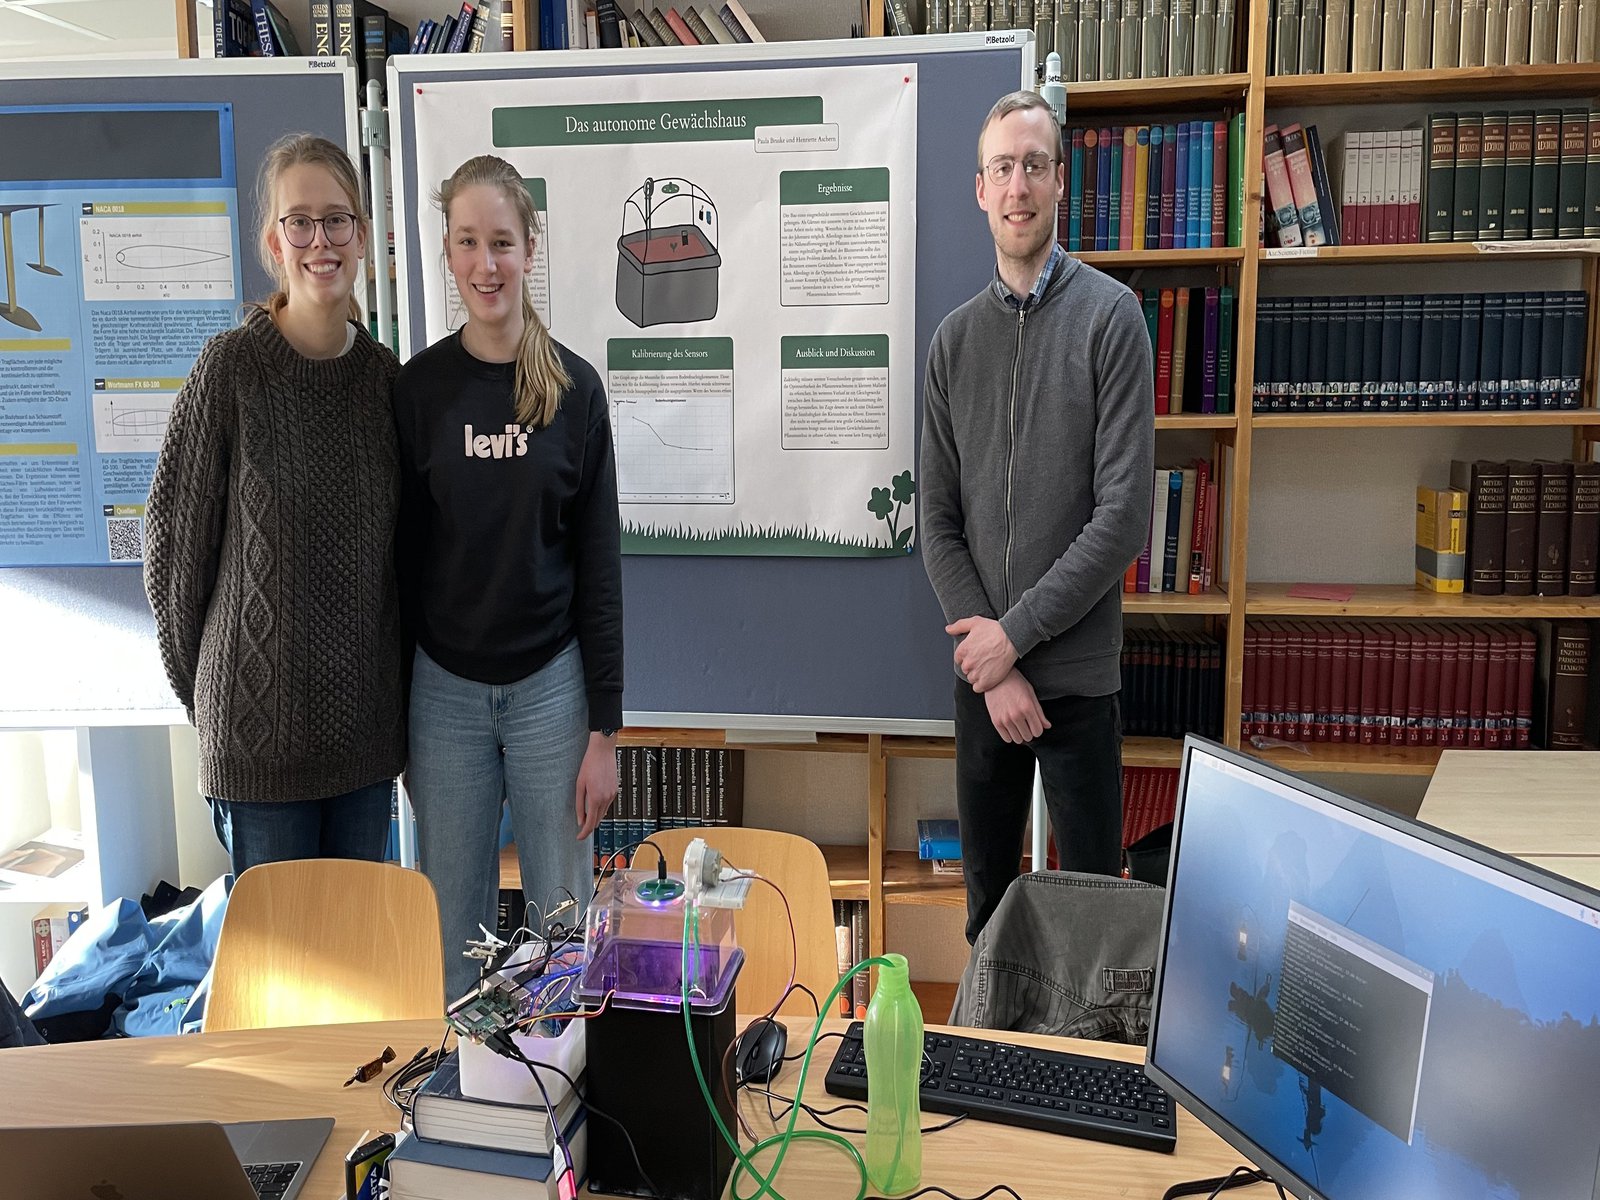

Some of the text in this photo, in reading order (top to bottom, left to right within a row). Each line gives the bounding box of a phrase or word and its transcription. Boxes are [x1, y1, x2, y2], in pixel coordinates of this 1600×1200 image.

[991, 34, 1014, 44] Betzold
[565, 110, 746, 133] Das autonome Gewächshaus
[818, 183, 853, 195] Ergebnisse
[632, 350, 672, 360] Kalibrierung
[685, 349, 708, 358] Sensors
[796, 347, 875, 357] Ausblick und Diskussion
[465, 424, 528, 459] levi's
